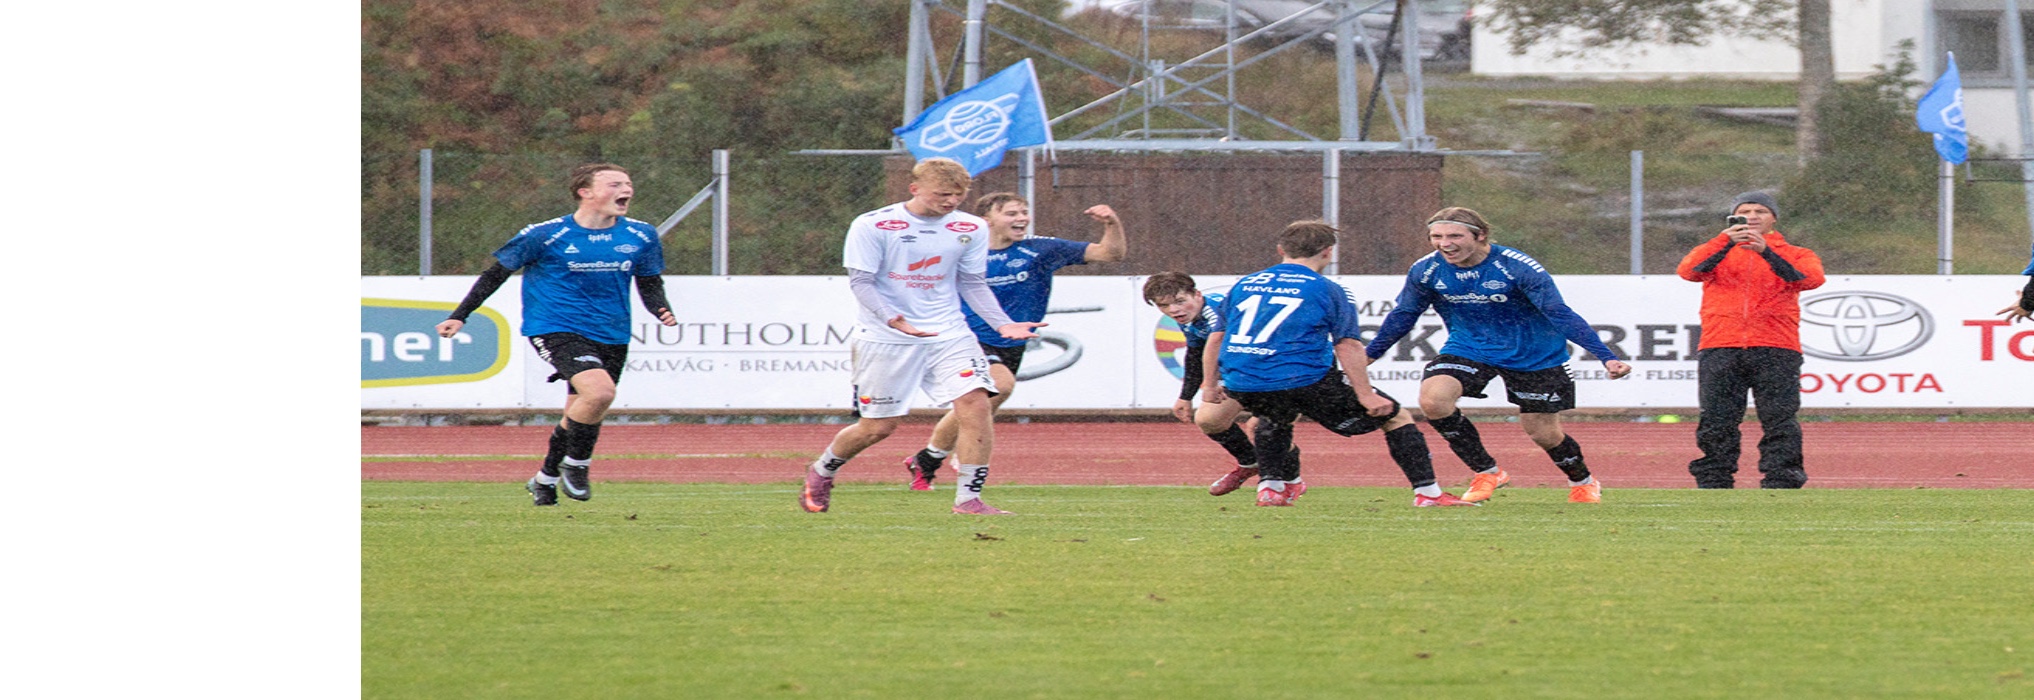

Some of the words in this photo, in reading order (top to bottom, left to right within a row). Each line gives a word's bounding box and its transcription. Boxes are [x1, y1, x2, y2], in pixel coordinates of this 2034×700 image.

[1229, 295, 1303, 343] 17
[361, 331, 473, 363] ner
[631, 322, 854, 346] NUTHOLM
[1799, 373, 1944, 394] OYOTA
